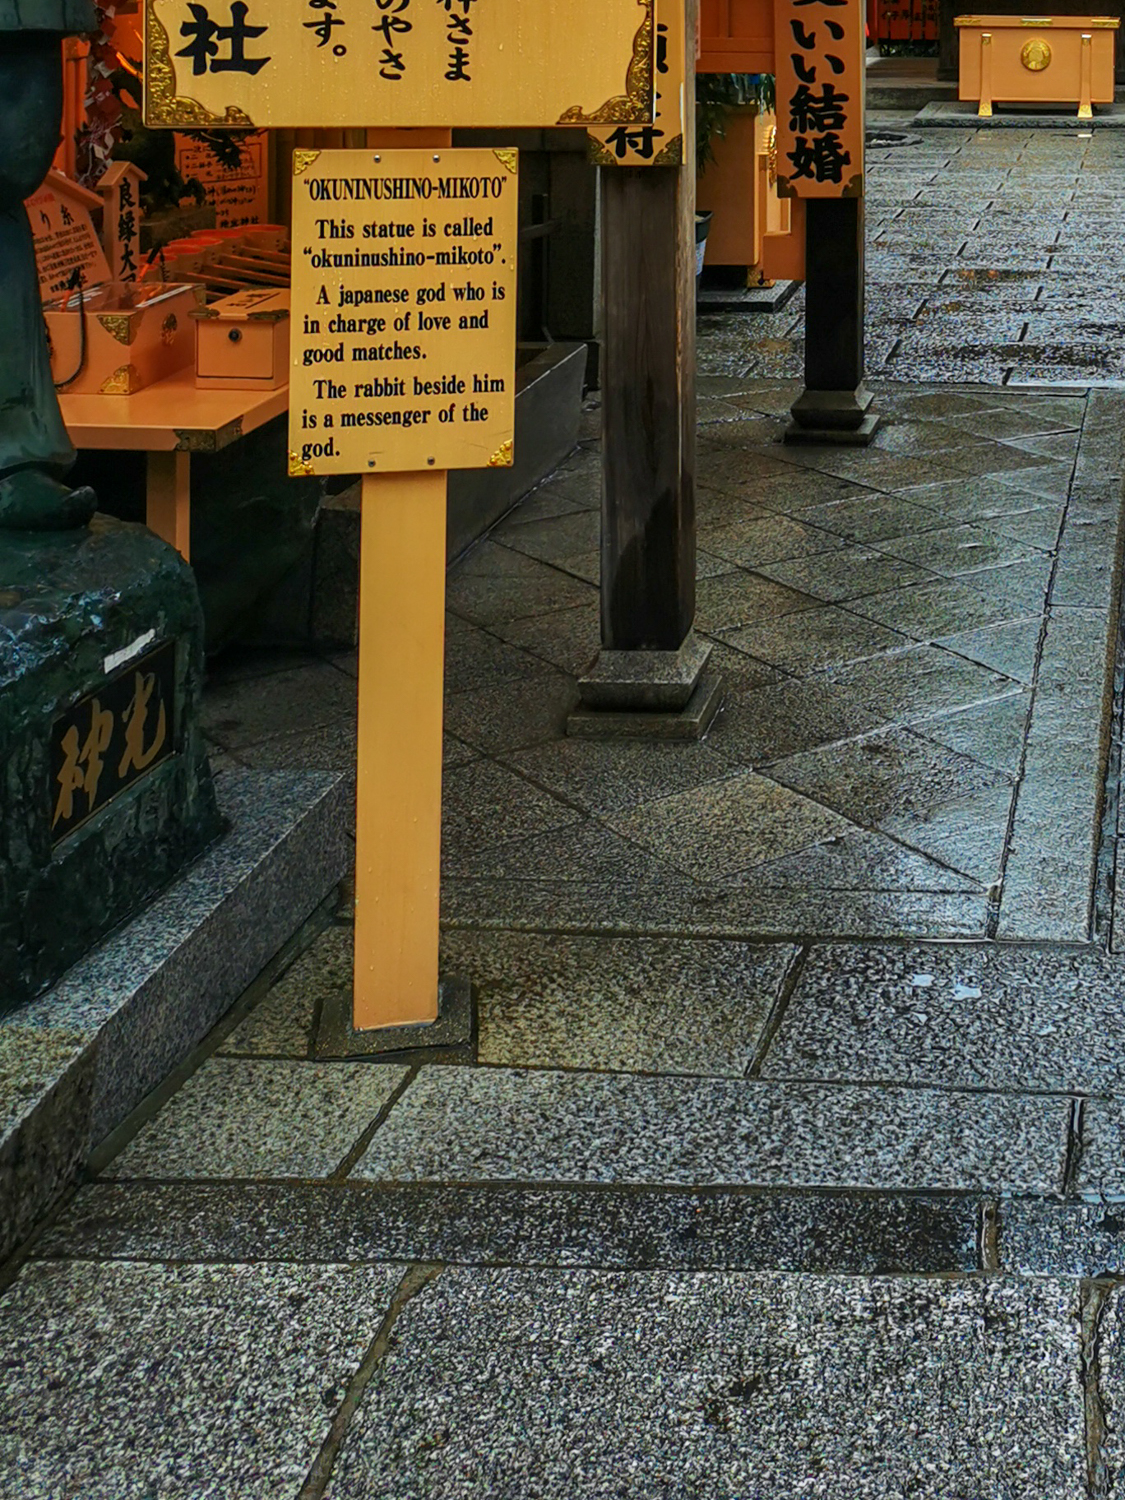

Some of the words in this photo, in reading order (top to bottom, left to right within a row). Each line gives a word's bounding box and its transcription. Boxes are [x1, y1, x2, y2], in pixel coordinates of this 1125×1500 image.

[304, 177, 507, 201] “OKUNINUSHINO-MIKOTO”
[315, 219, 354, 239] This
[363, 221, 414, 239] statue
[422, 218, 436, 237] is
[444, 217, 493, 236] called
[303, 244, 506, 268] “okuninushino-mikoto”.
[316, 285, 330, 304] A
[338, 285, 409, 307] japanese
[416, 282, 445, 306] god
[453, 282, 485, 301] who
[492, 281, 505, 300] is
[303, 315, 320, 334] in
[328, 313, 386, 335] charge
[394, 312, 411, 331] of
[418, 311, 451, 330] love
[459, 310, 488, 329] and
[303, 342, 344, 366] good
[352, 341, 427, 361] matches.
[313, 380, 347, 399] The
[354, 377, 406, 397] rabbit
[413, 375, 466, 396] beside
[473, 374, 505, 393] him
[302, 409, 317, 428] is
[323, 413, 333, 428] a
[341, 407, 431, 428] messenger
[438, 404, 455, 423] of
[462, 404, 488, 422] the
[302, 437, 340, 461] god.
